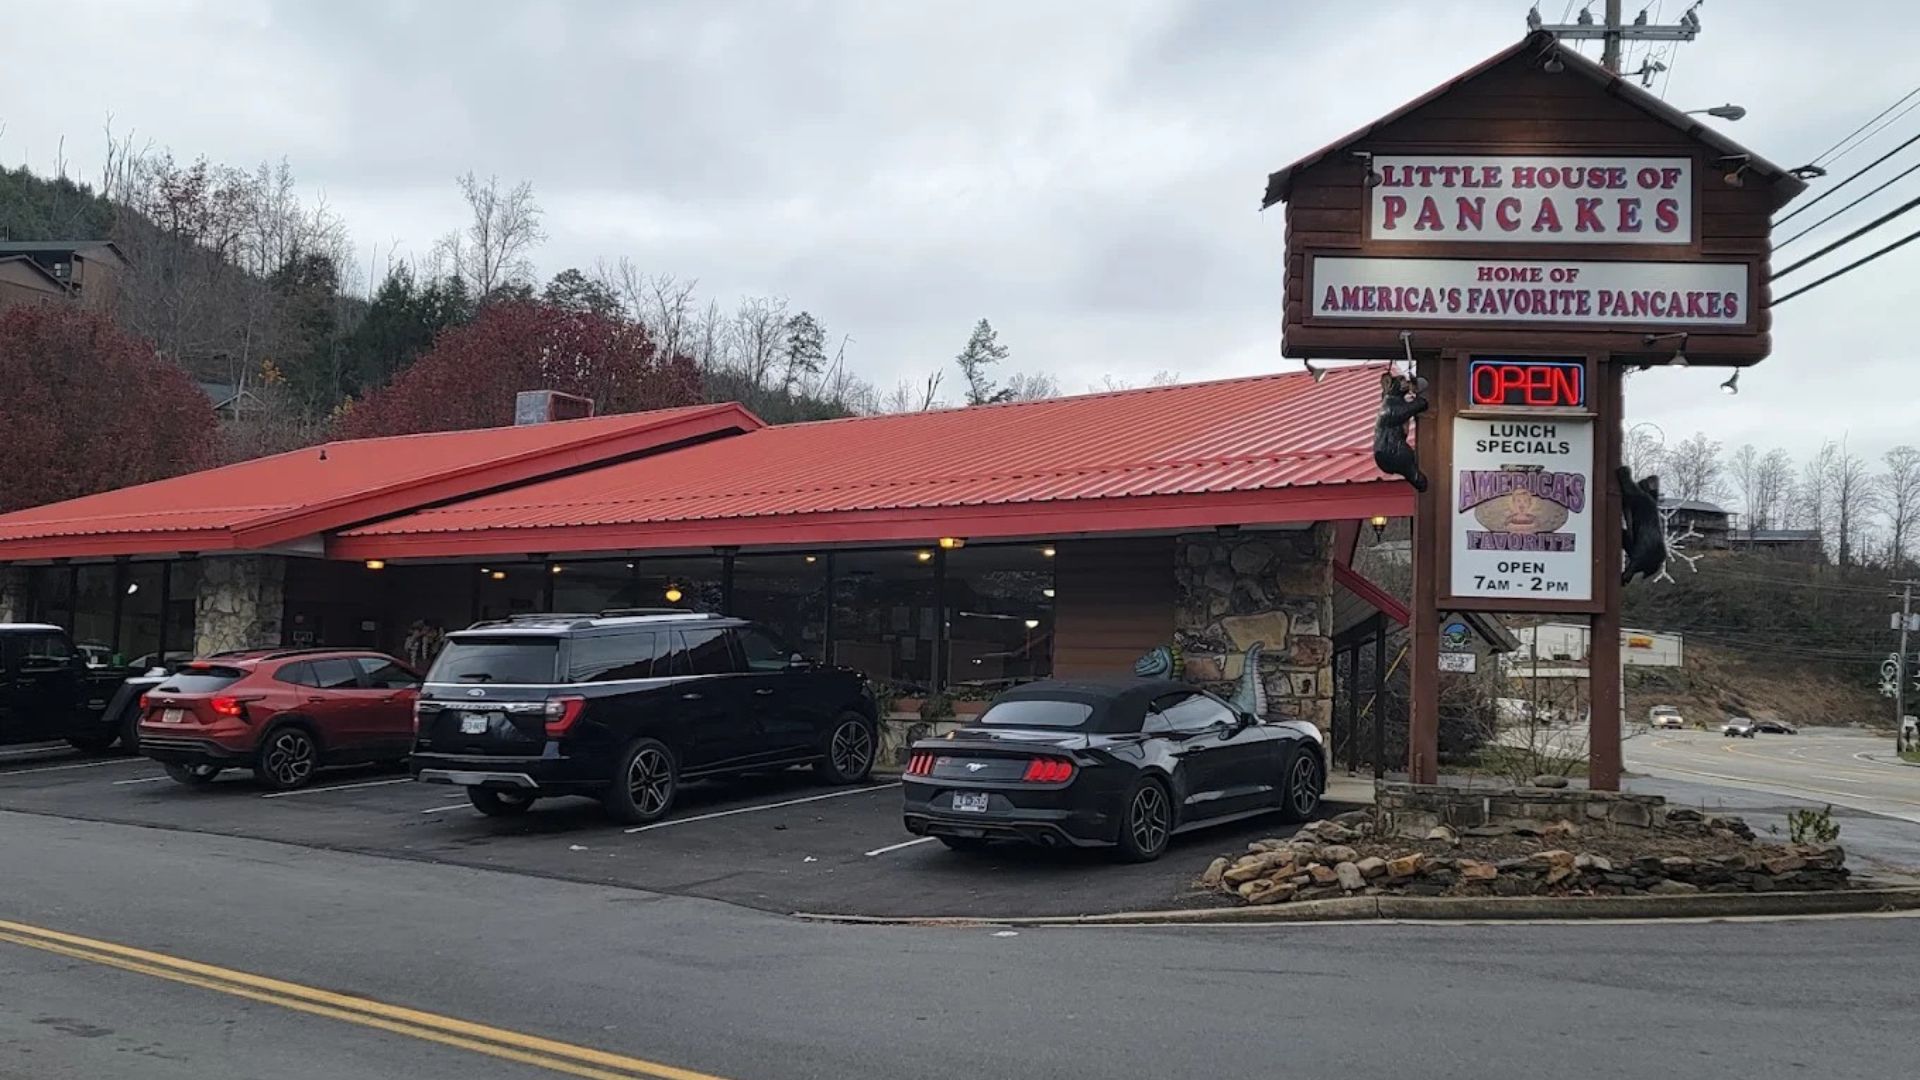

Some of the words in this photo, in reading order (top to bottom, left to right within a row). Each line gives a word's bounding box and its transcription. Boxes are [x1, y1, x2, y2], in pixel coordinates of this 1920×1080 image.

[1382, 166, 1502, 188] LITTLE
[1512, 166, 1627, 189] HOUSE
[1637, 167, 1682, 189] OF
[1382, 195, 1680, 233] PANCAKES
[1477, 266, 1543, 283] HOME
[1549, 268, 1580, 283] OF
[1321, 285, 1462, 314] AMERICA'S
[1466, 287, 1591, 316] FAVORITE
[1597, 289, 1738, 318] PANCAKES
[1474, 365, 1579, 406] OPEN
[1490, 424, 1556, 438] LUNCH
[1476, 440, 1570, 455] SPECIALS
[1459, 470, 1585, 513] AMERICA'S
[1467, 530, 1576, 552] FAVORITE
[1497, 561, 1545, 574] OPEN
